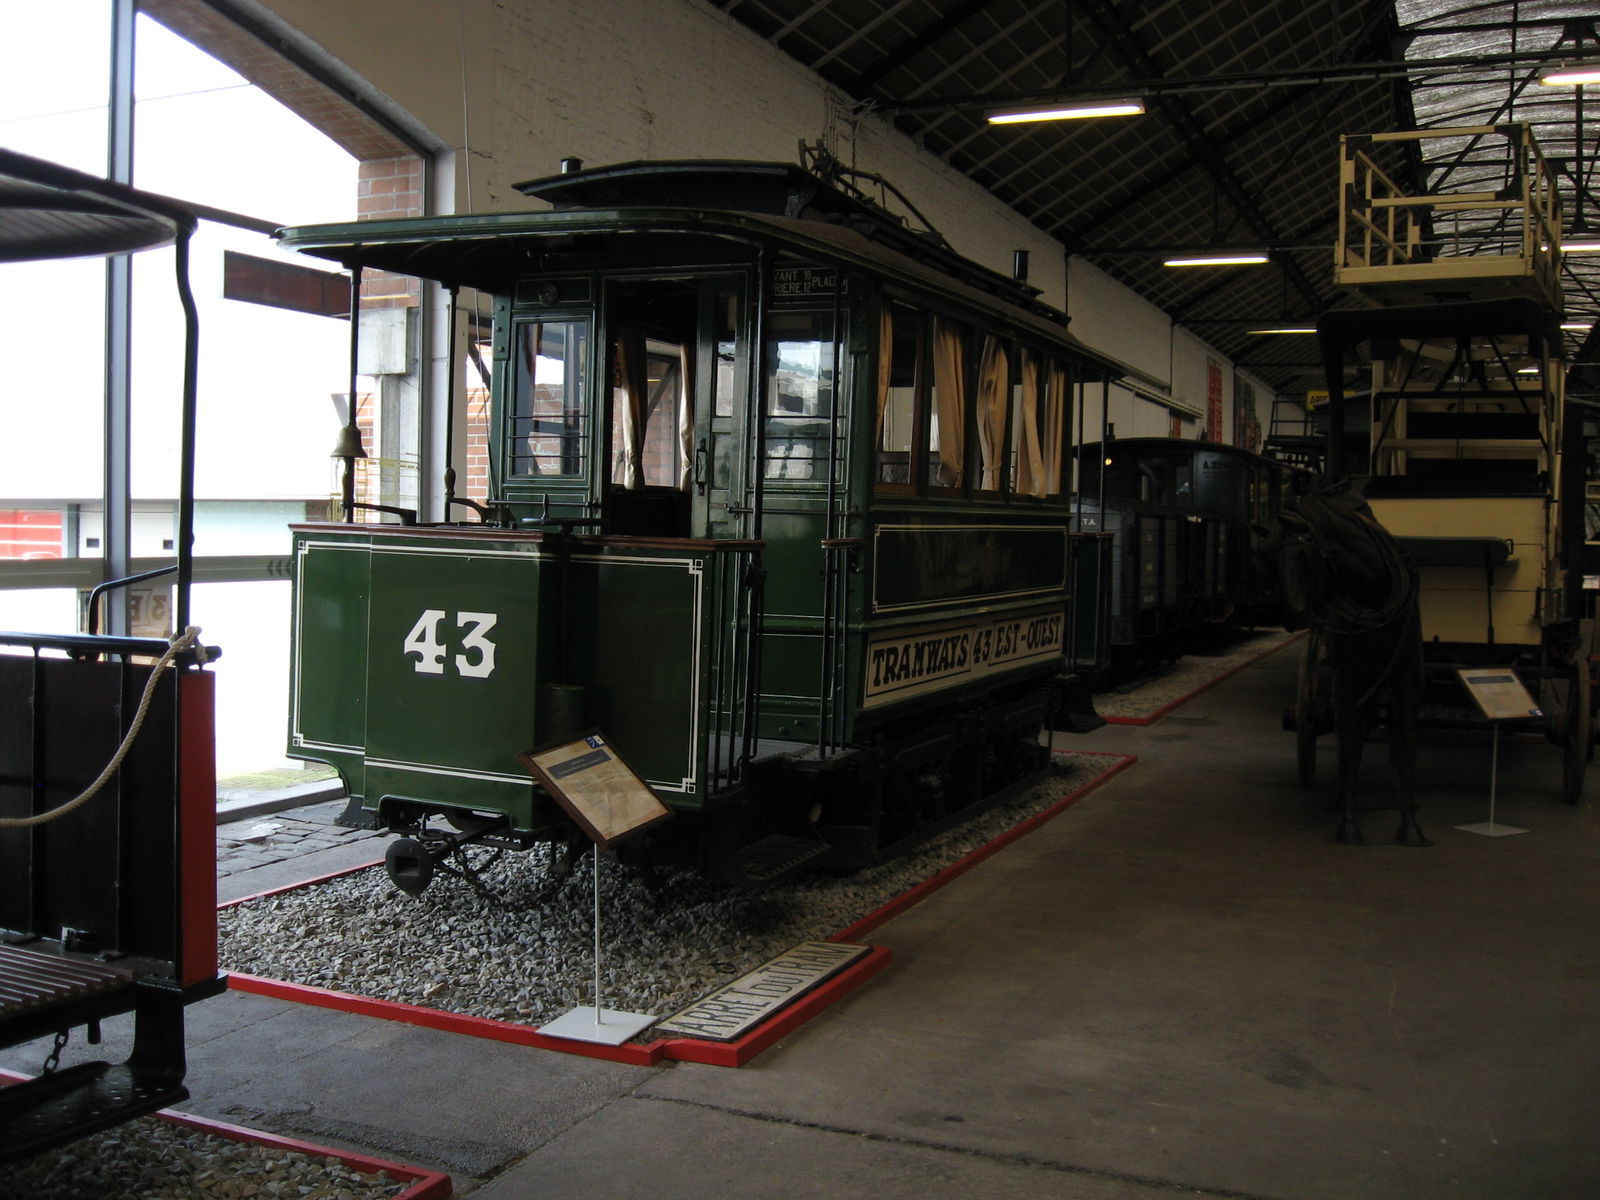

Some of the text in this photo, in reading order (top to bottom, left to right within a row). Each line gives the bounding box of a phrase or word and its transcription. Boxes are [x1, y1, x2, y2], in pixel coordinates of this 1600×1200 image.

[403, 609, 497, 679] 43
[872, 616, 1061, 687] TRAMWAYS 43 EST-OUEST
[669, 943, 858, 1036] ARRET DU TRAM
